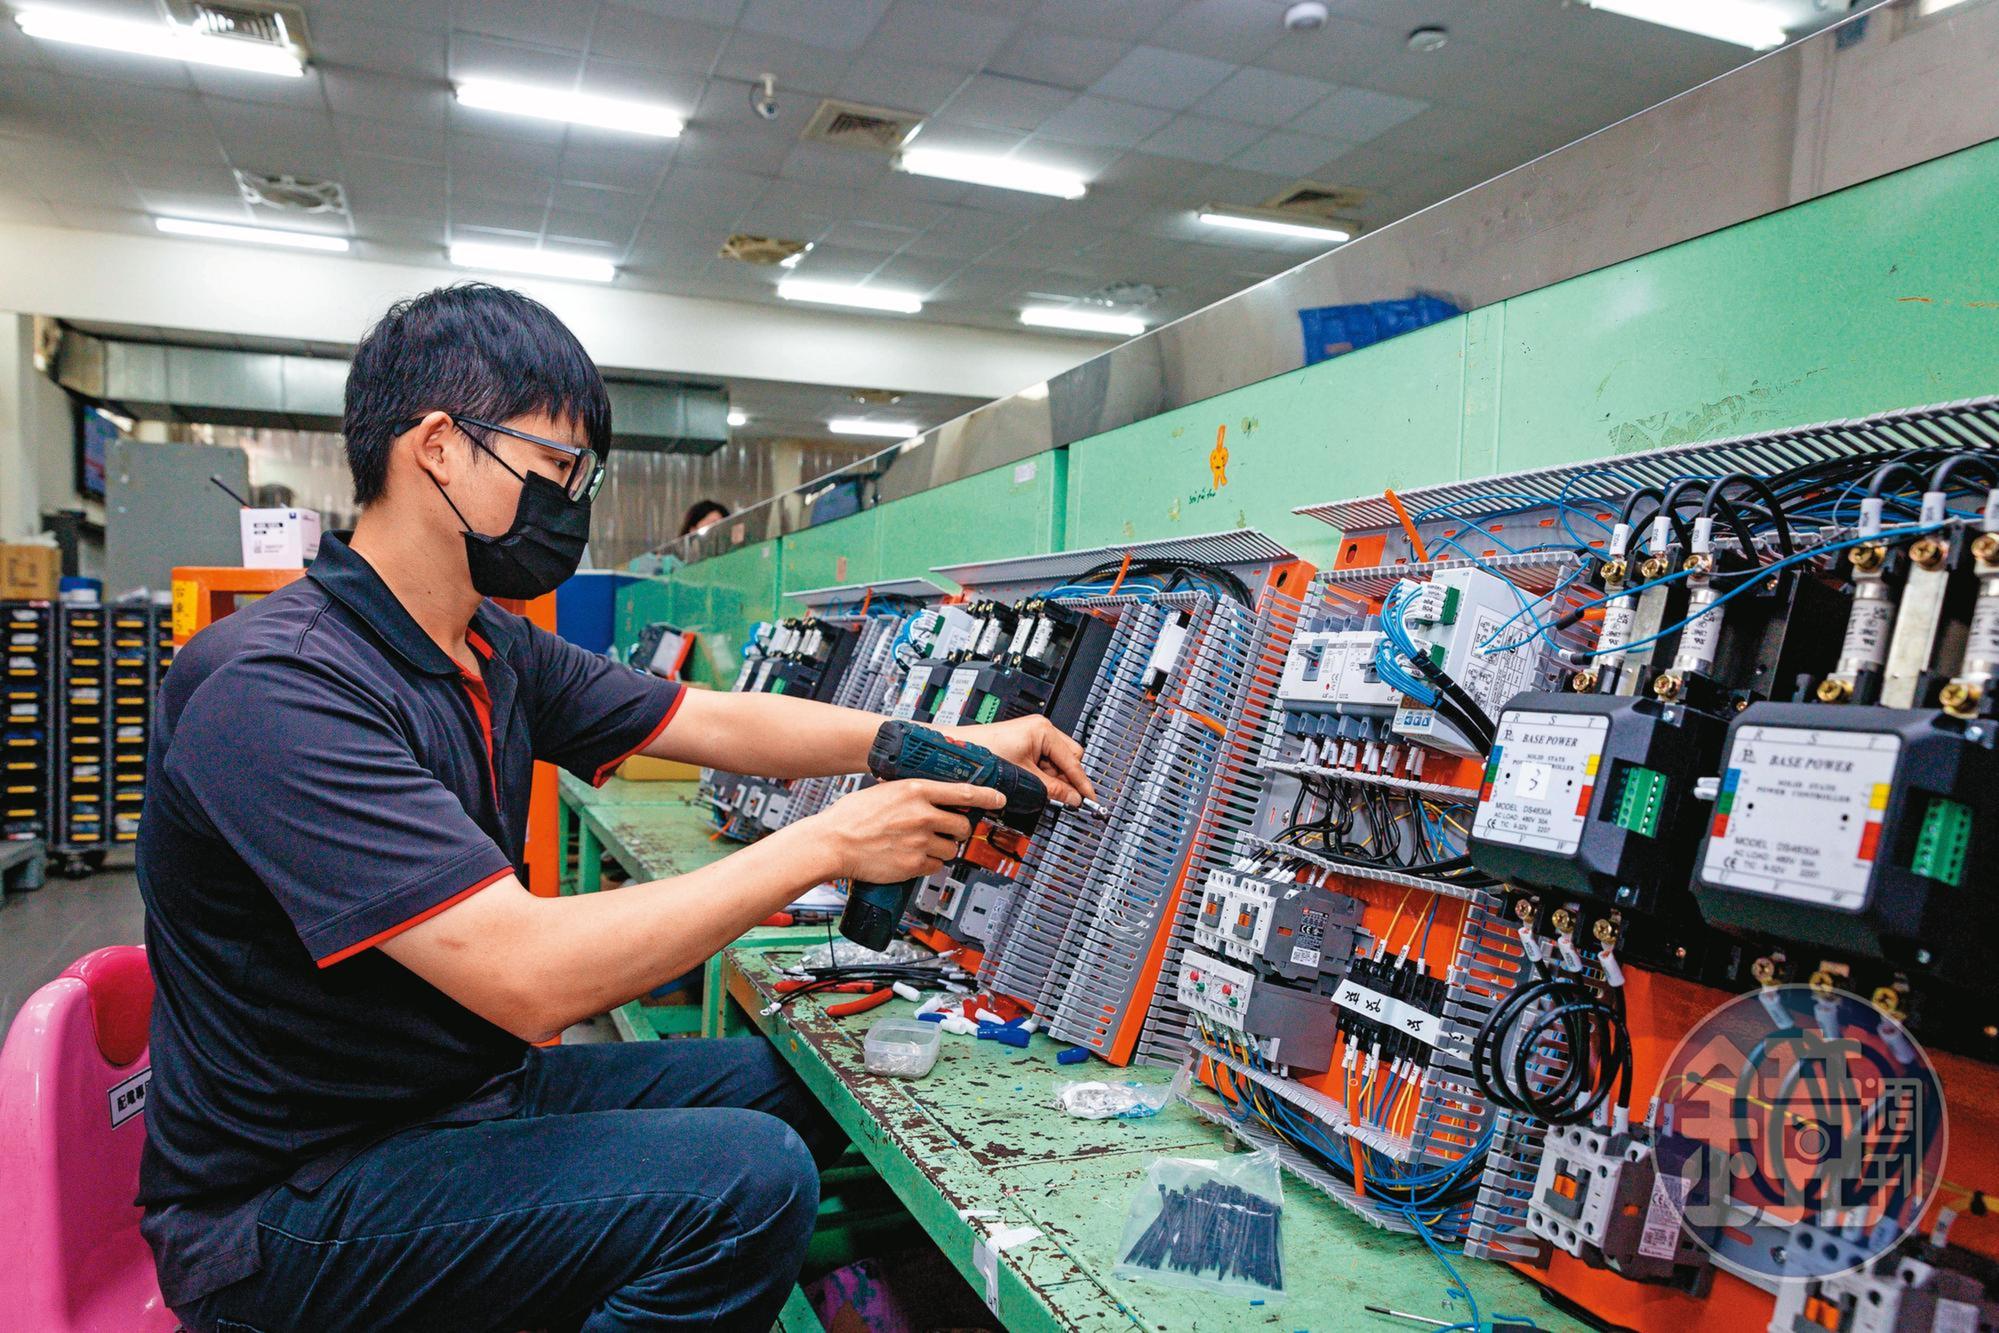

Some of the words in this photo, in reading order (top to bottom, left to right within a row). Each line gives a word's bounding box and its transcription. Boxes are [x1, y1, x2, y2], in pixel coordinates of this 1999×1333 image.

[1522, 734, 1544, 744] BASE
[1545, 735, 1578, 747] POWER
[1769, 755, 1800, 768] BASE
[1805, 758, 1854, 773] POWER
[1495, 802, 1518, 812] MODEL
